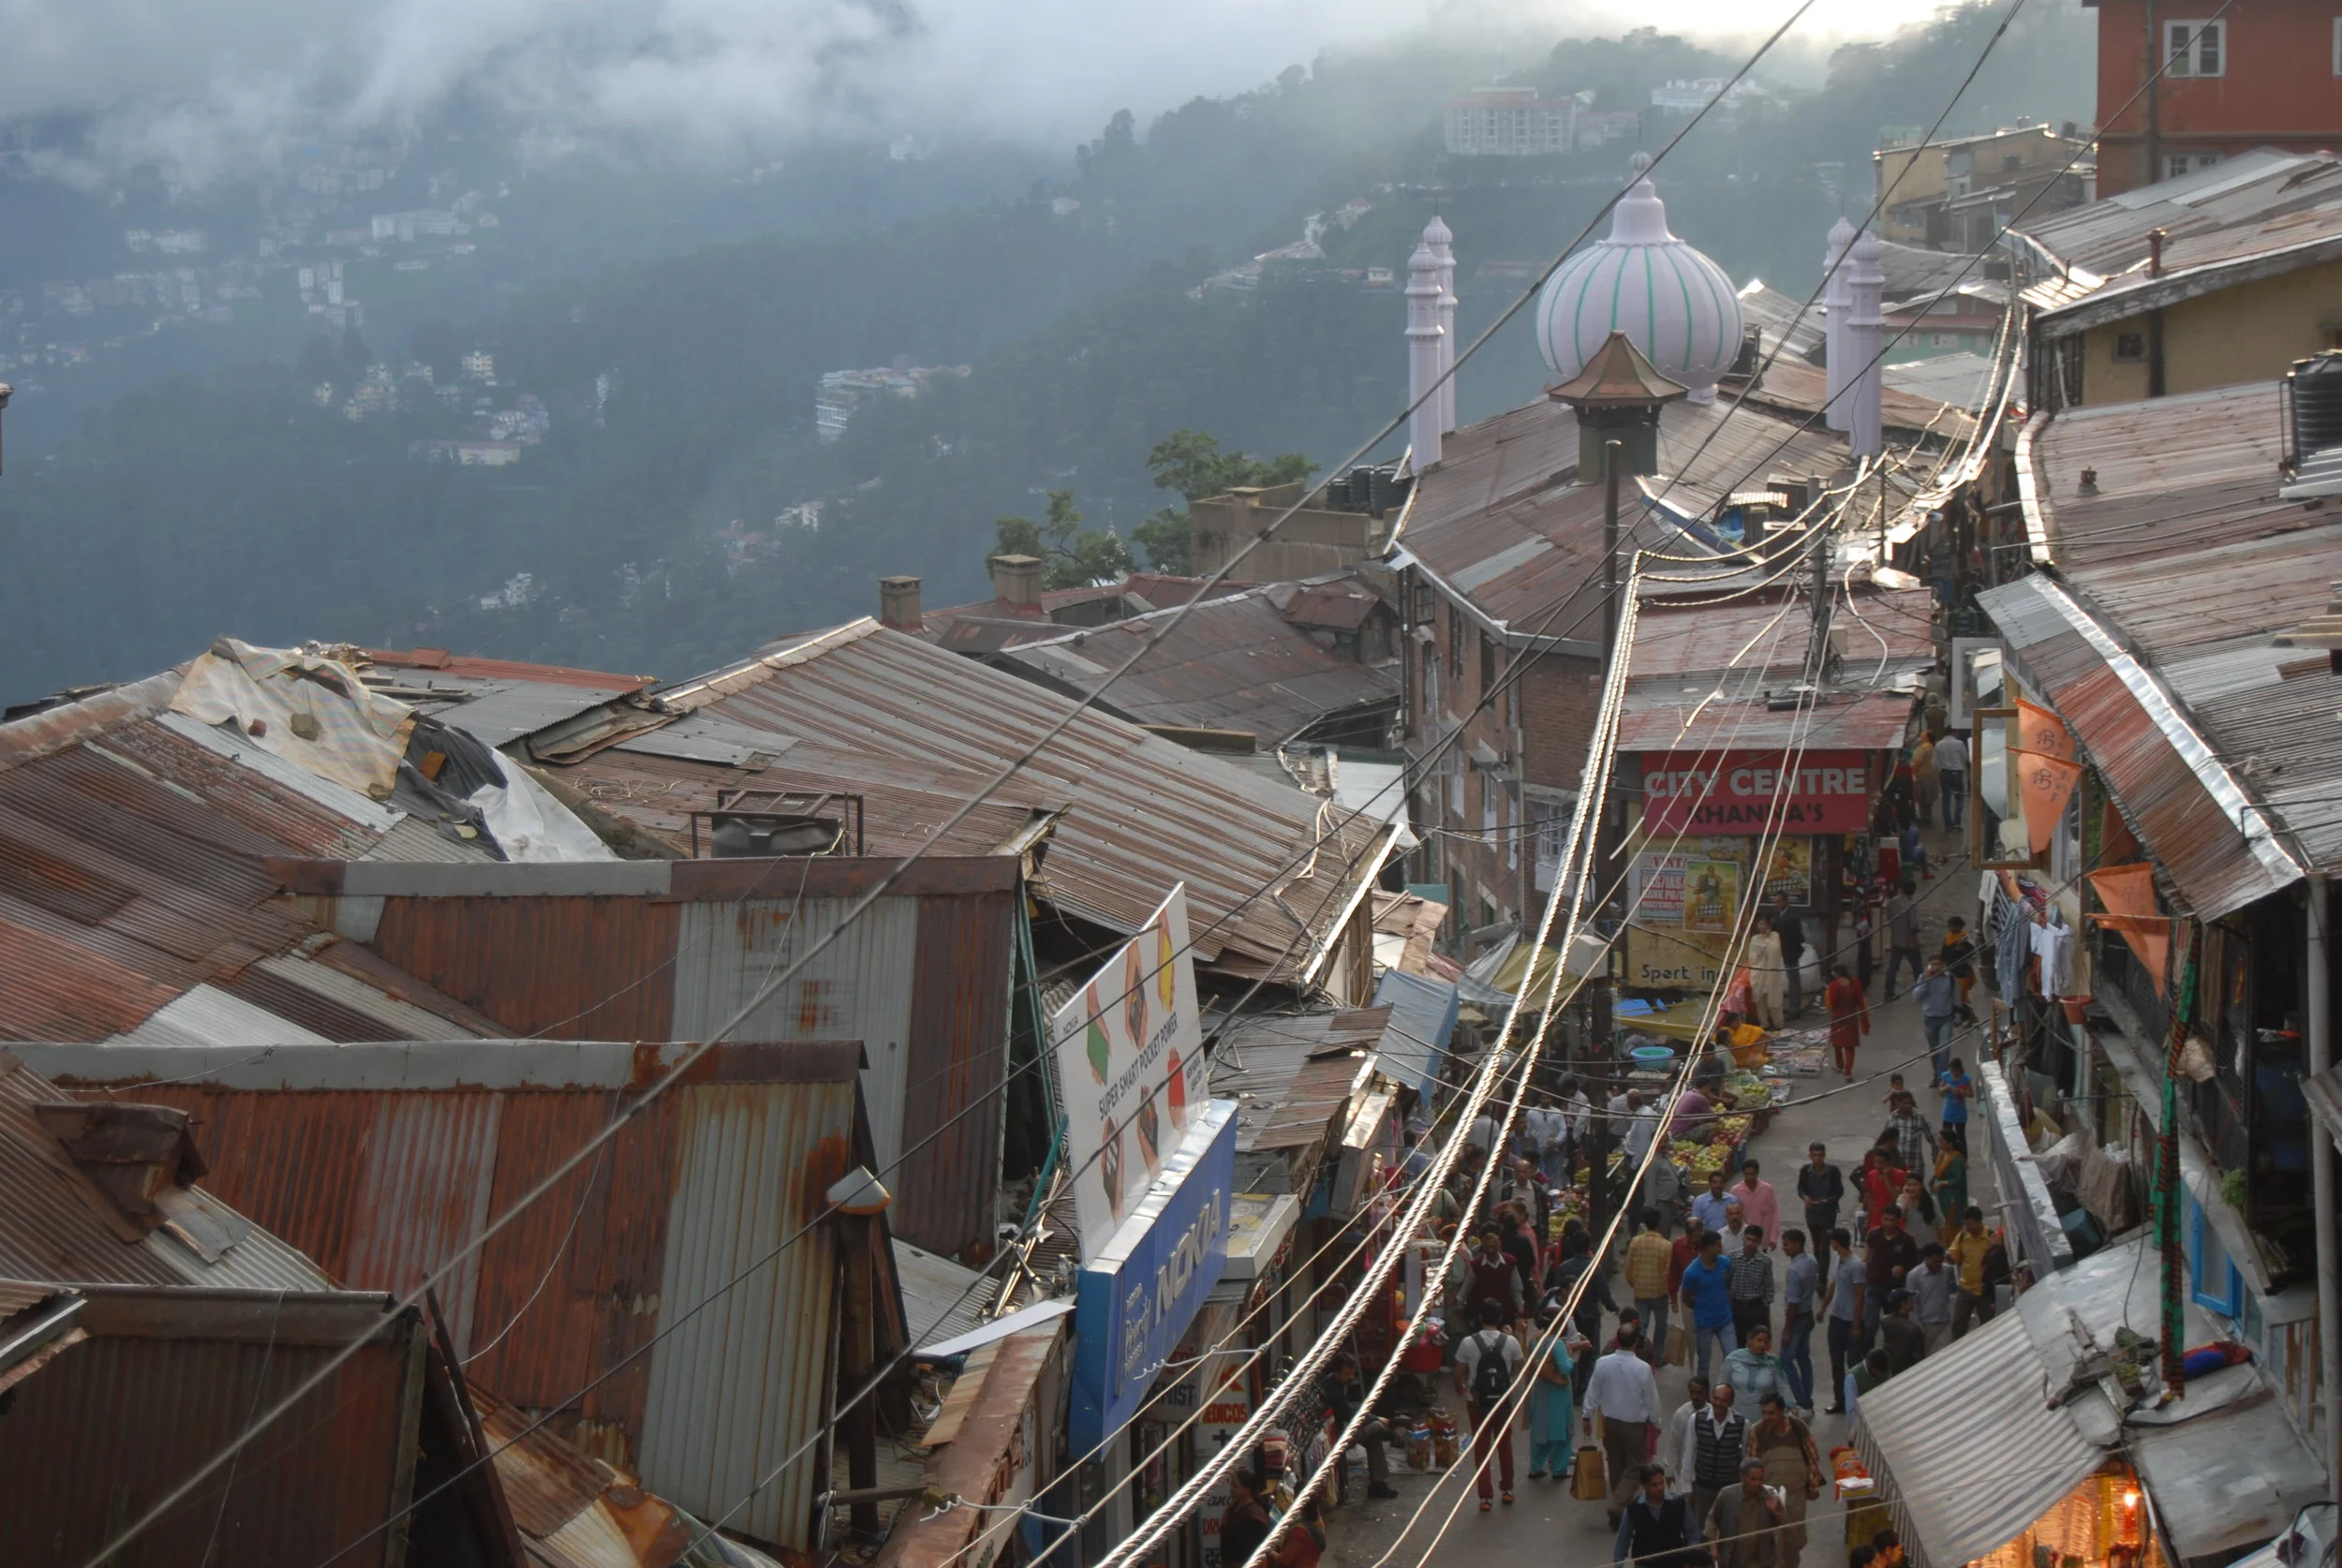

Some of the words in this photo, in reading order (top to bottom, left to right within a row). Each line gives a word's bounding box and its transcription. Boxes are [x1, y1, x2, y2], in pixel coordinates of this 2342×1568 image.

[1644, 769, 1720, 798] CITY
[1729, 768, 1866, 796] CENTRE
[1687, 803, 1824, 824] KHANNA'S
[1099, 1083, 1119, 1121] SUPER
[1119, 1058, 1139, 1098] SMART
[1139, 1033, 1160, 1074] POCKET
[1160, 1012, 1178, 1048] POWER
[1155, 1188, 1222, 1326] NOKIA
